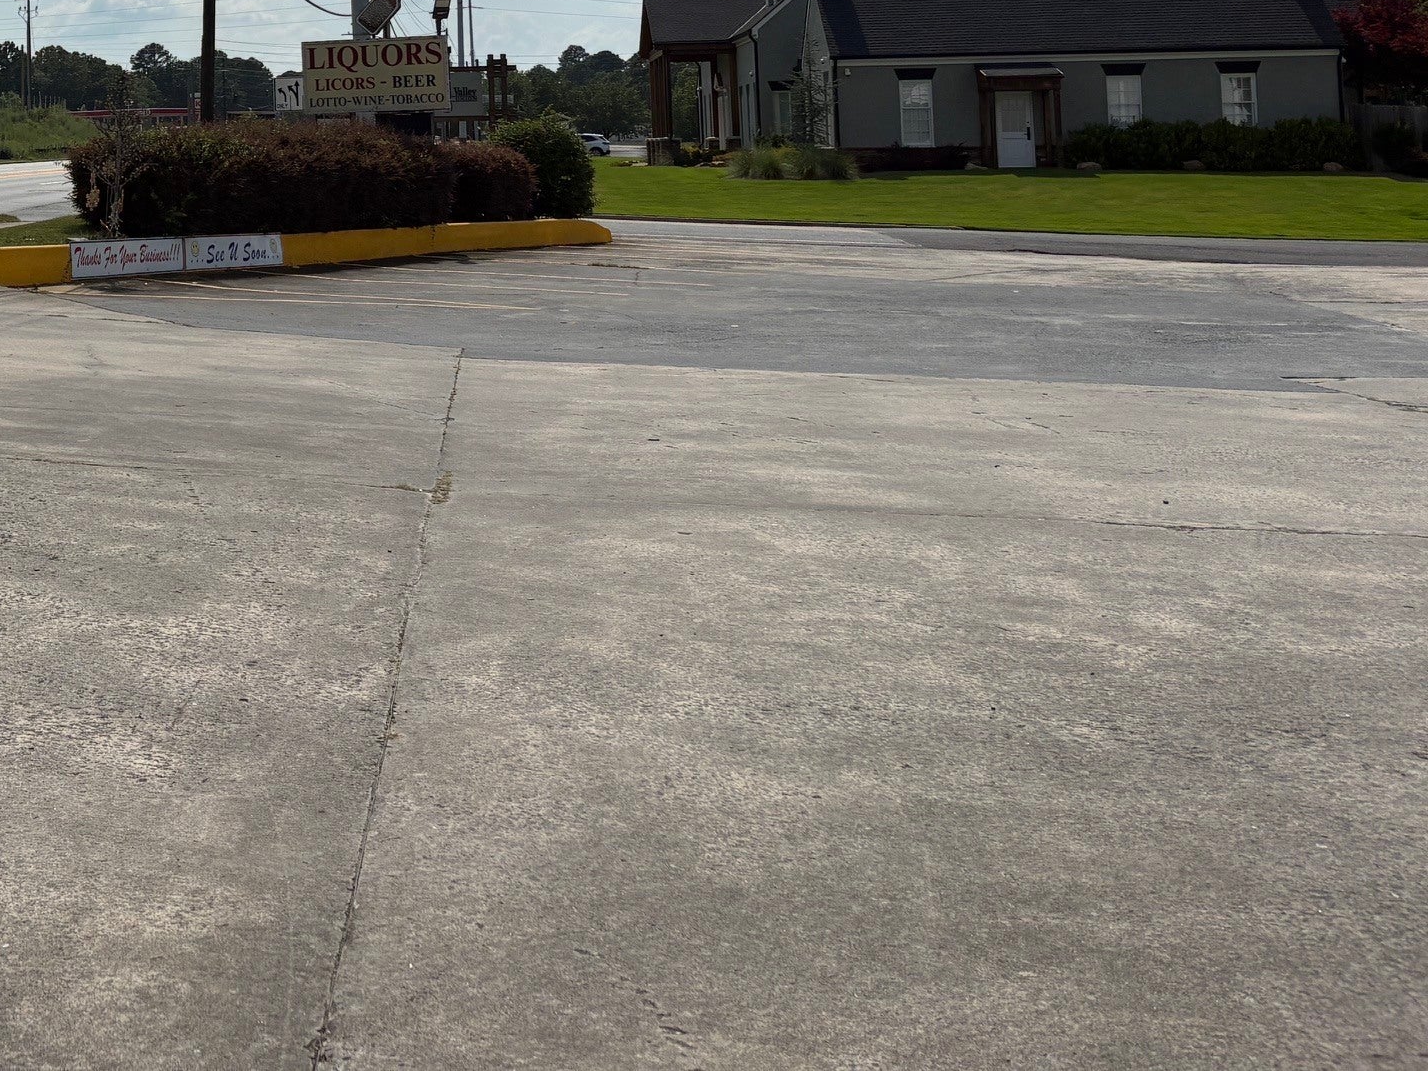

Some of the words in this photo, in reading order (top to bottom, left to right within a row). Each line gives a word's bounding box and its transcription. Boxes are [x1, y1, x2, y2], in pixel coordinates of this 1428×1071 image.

[307, 41, 442, 72] LIQUORS
[315, 76, 376, 92] LICORS
[392, 74, 437, 89] BEER
[309, 93, 445, 108] LOTTO-WINE-TOBACCO
[74, 246, 101, 268] Thanks
[104, 246, 118, 269] For
[119, 244, 137, 271] Your
[140, 243, 181, 264] Business!!!
[228, 241, 239, 261] U
